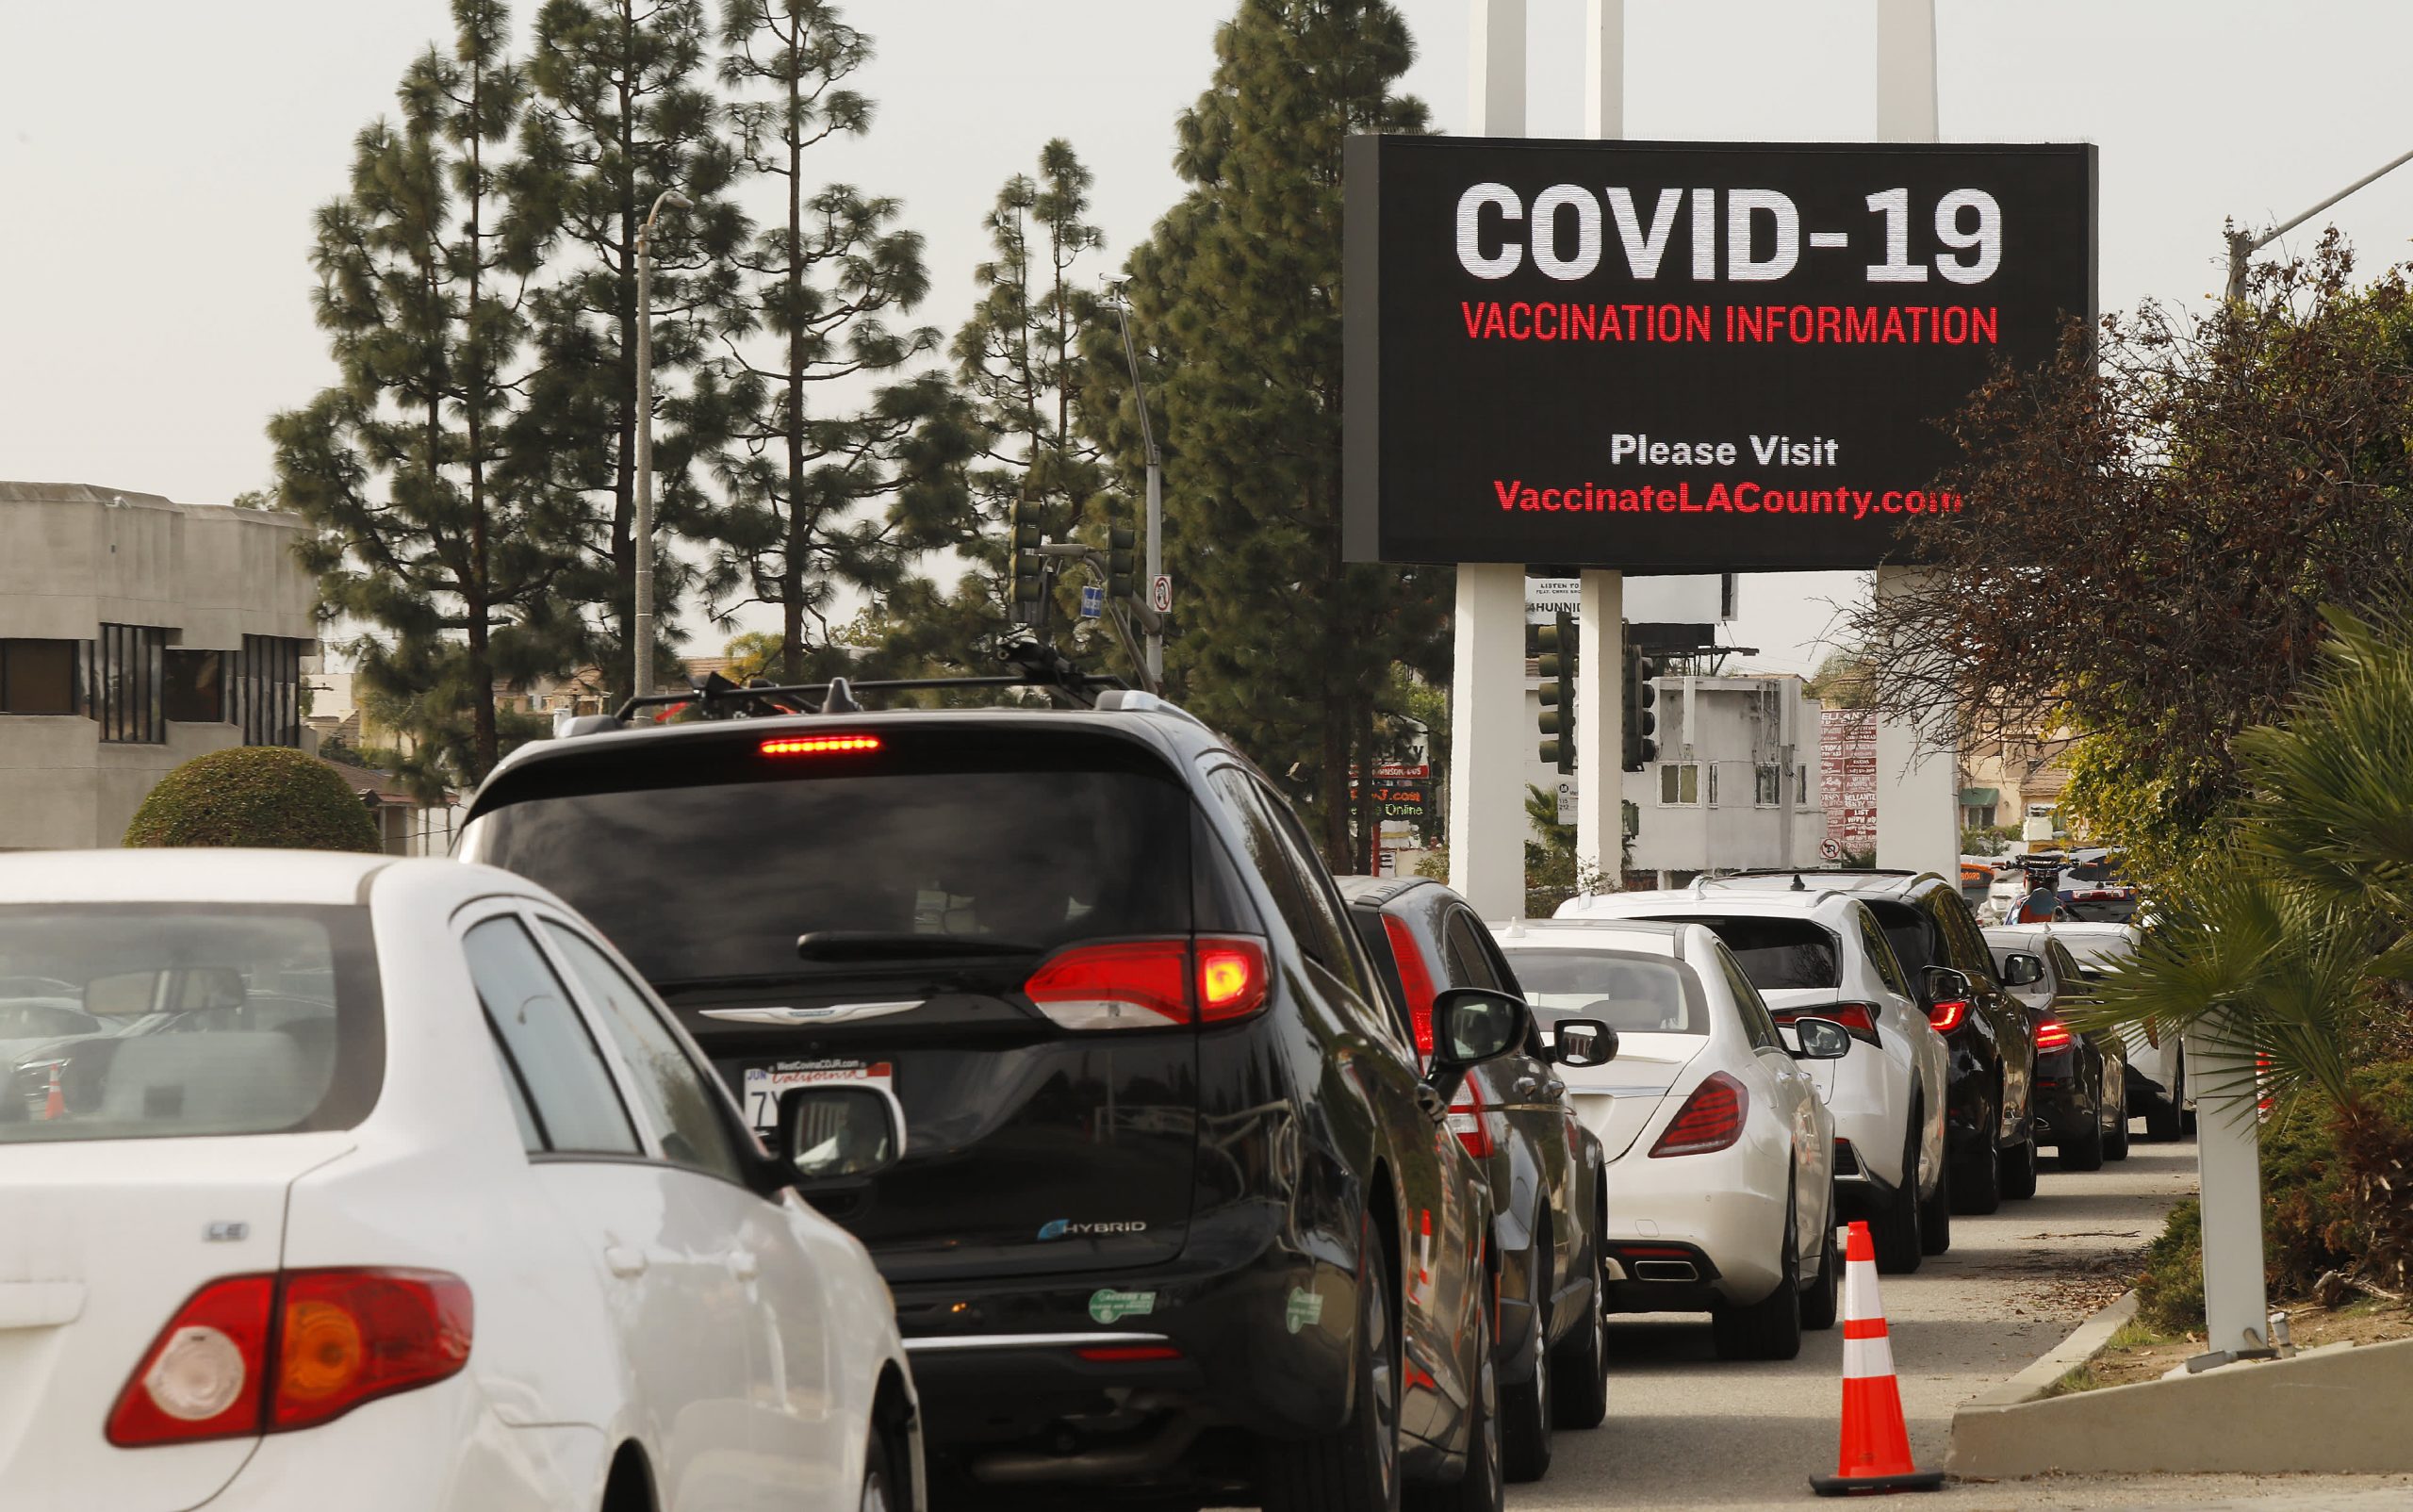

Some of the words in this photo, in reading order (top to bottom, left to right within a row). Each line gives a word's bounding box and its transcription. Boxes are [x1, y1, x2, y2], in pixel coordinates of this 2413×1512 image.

[1456, 182, 2003, 285] COVID-19
[1462, 301, 1711, 343] VACCINATION
[1726, 304, 1998, 346] INFORMATION
[1611, 434, 1737, 466] Please
[1749, 435, 1839, 467] Visit
[1493, 479, 1962, 520] VaccinateLACounty.com
[1385, 803, 1424, 816] Online
[747, 1070, 767, 1081] JUN
[771, 1070, 860, 1084] California
[1062, 1222, 1147, 1234] HYBRID
